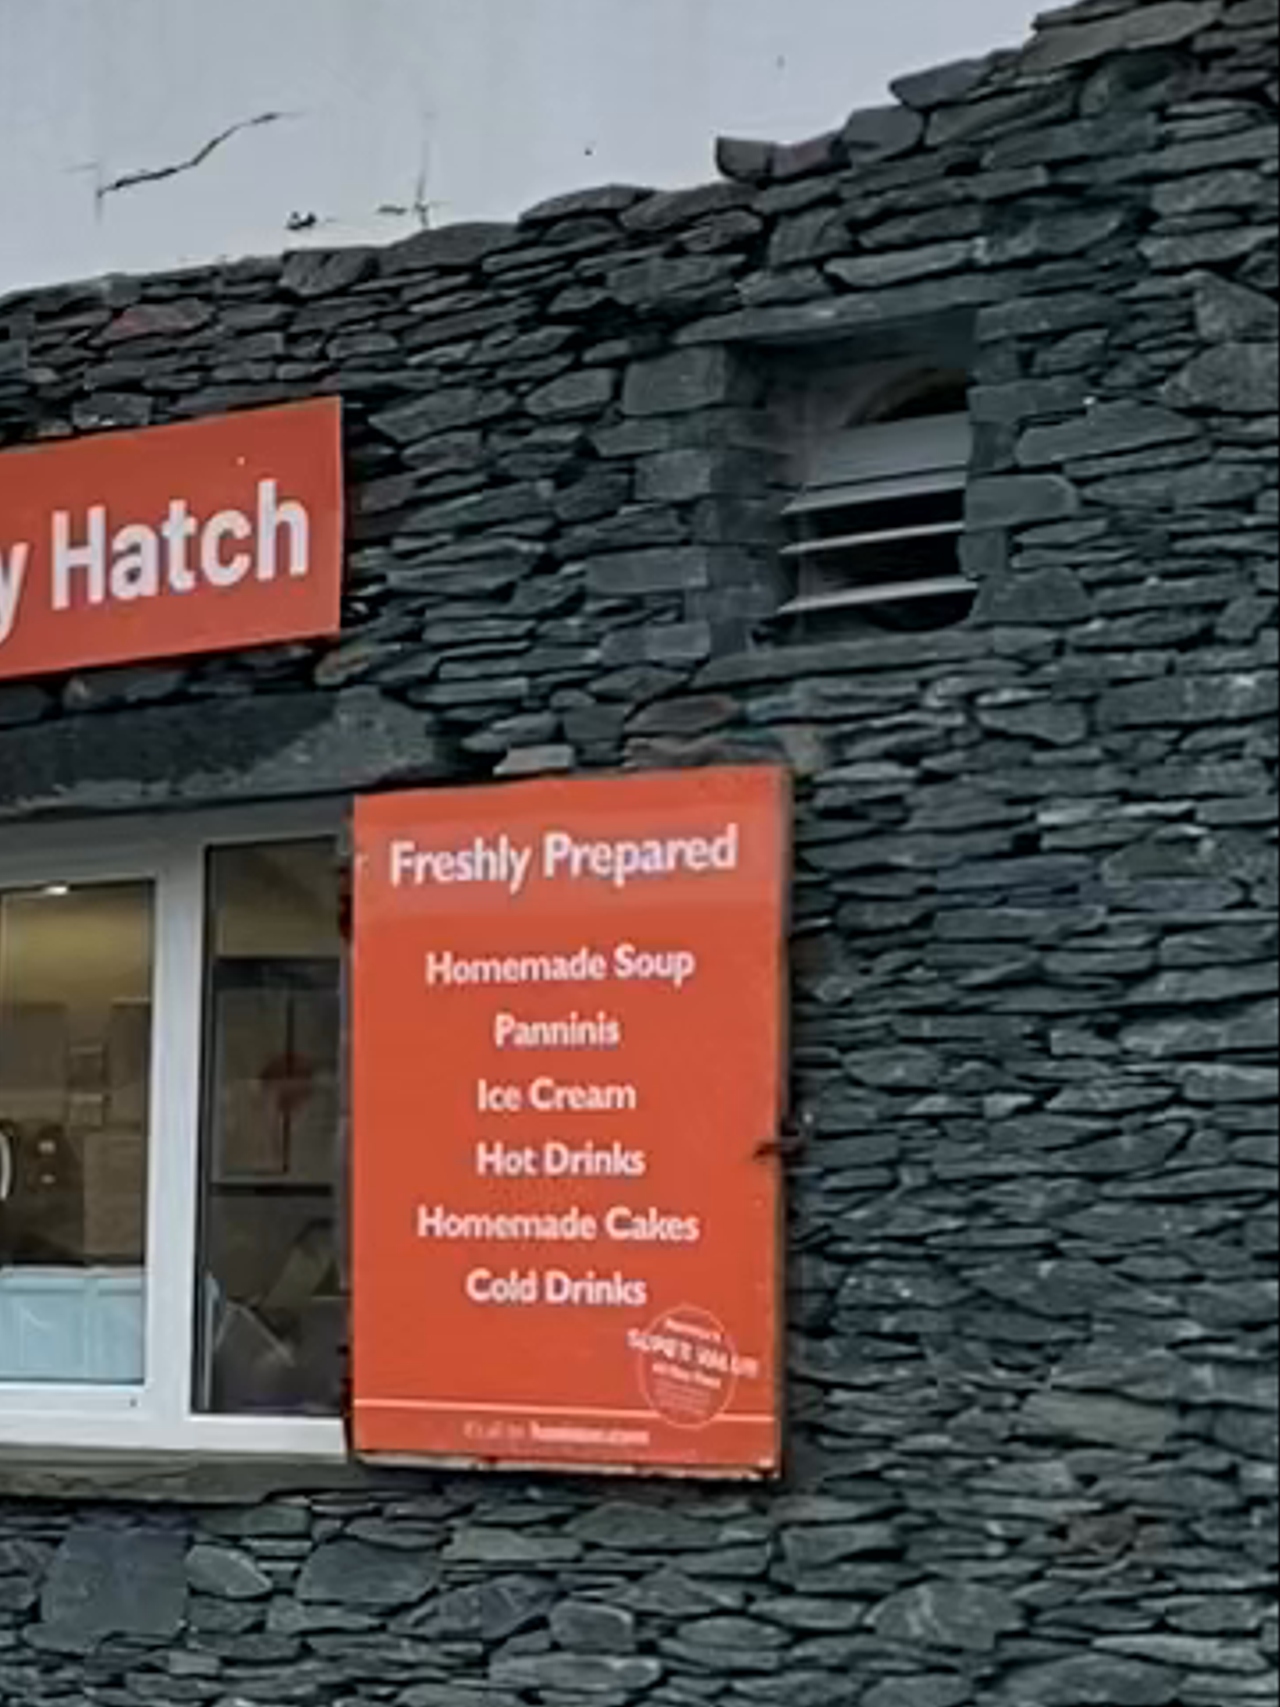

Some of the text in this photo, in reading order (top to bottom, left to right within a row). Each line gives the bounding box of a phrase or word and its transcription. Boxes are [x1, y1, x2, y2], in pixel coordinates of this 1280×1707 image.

[51, 478, 310, 611] Hatch
[389, 822, 739, 894] Freshly Prepared
[425, 942, 697, 988] Homemade Soup
[493, 1012, 621, 1049] Panninis
[477, 1077, 637, 1112] Ice Cream
[476, 1142, 646, 1177] Hot Drinks
[416, 1205, 700, 1243] Homemade Cakes
[465, 1268, 648, 1307] Cold Drinks
